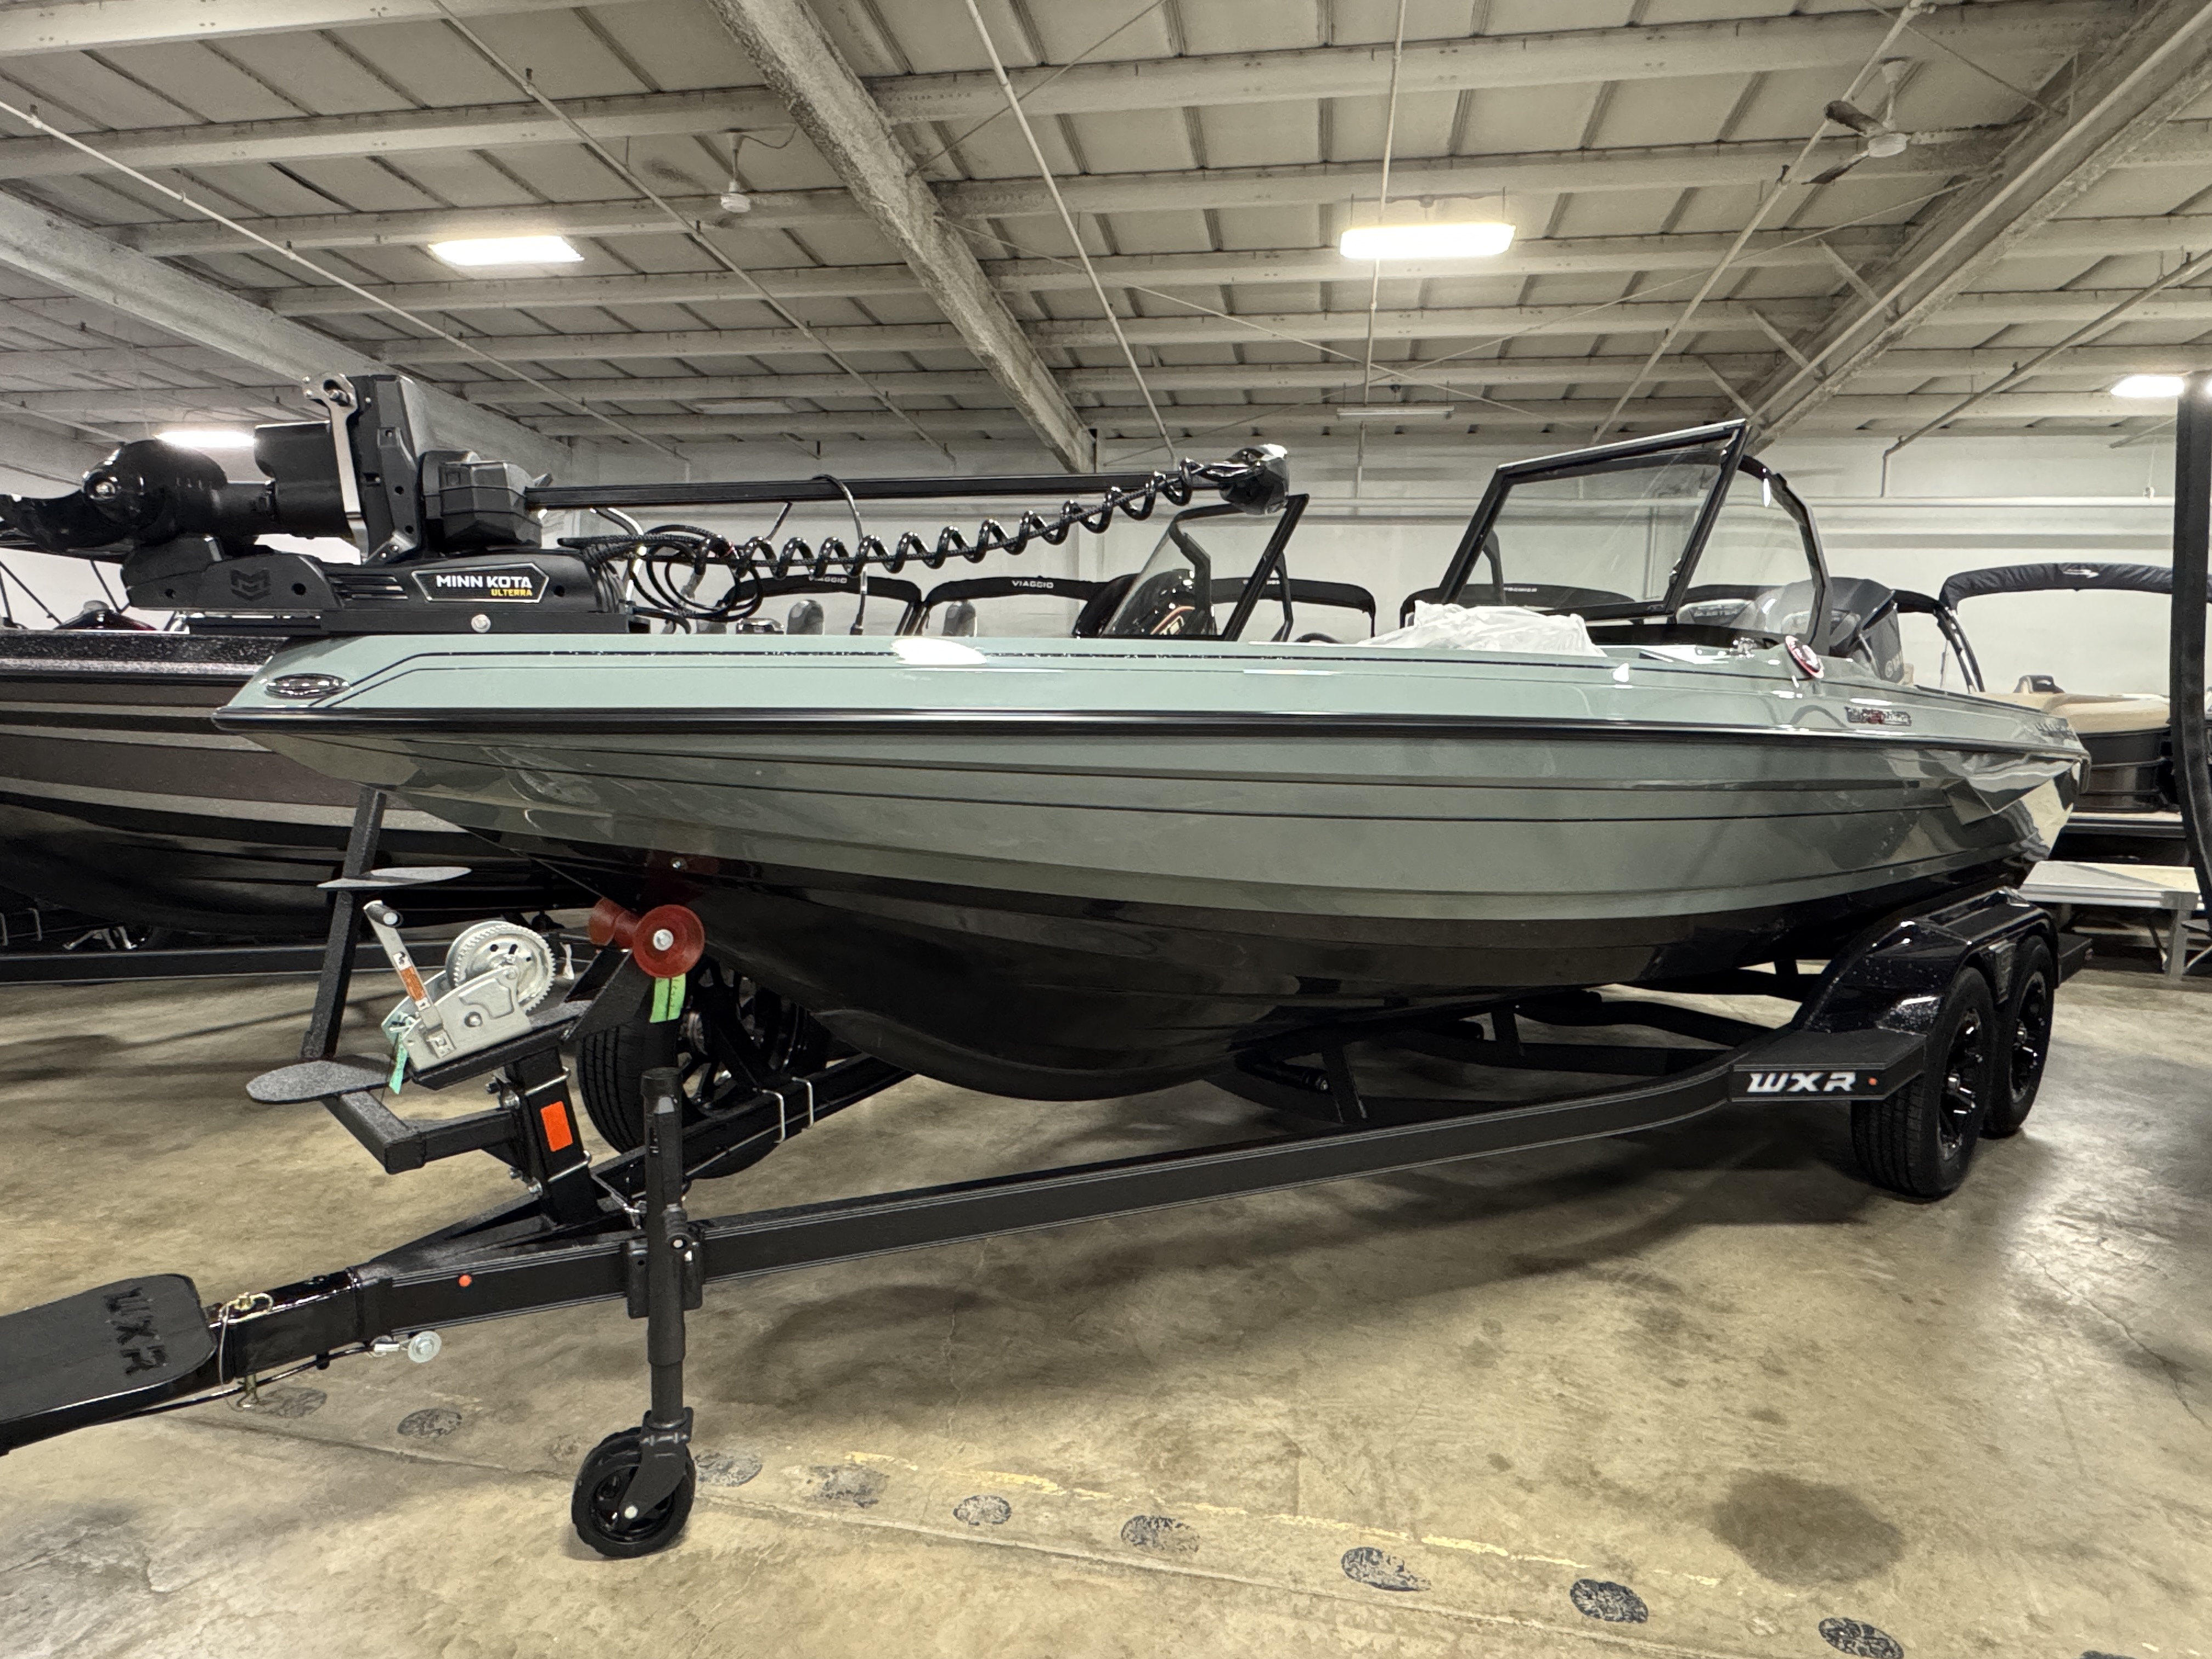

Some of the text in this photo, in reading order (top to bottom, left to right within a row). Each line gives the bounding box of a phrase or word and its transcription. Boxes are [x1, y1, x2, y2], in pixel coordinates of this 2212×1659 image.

[436, 575, 533, 588] MINN KOTA
[1012, 580, 1054, 589] VIAGGIO
[1747, 1072, 1856, 1093] WXR
